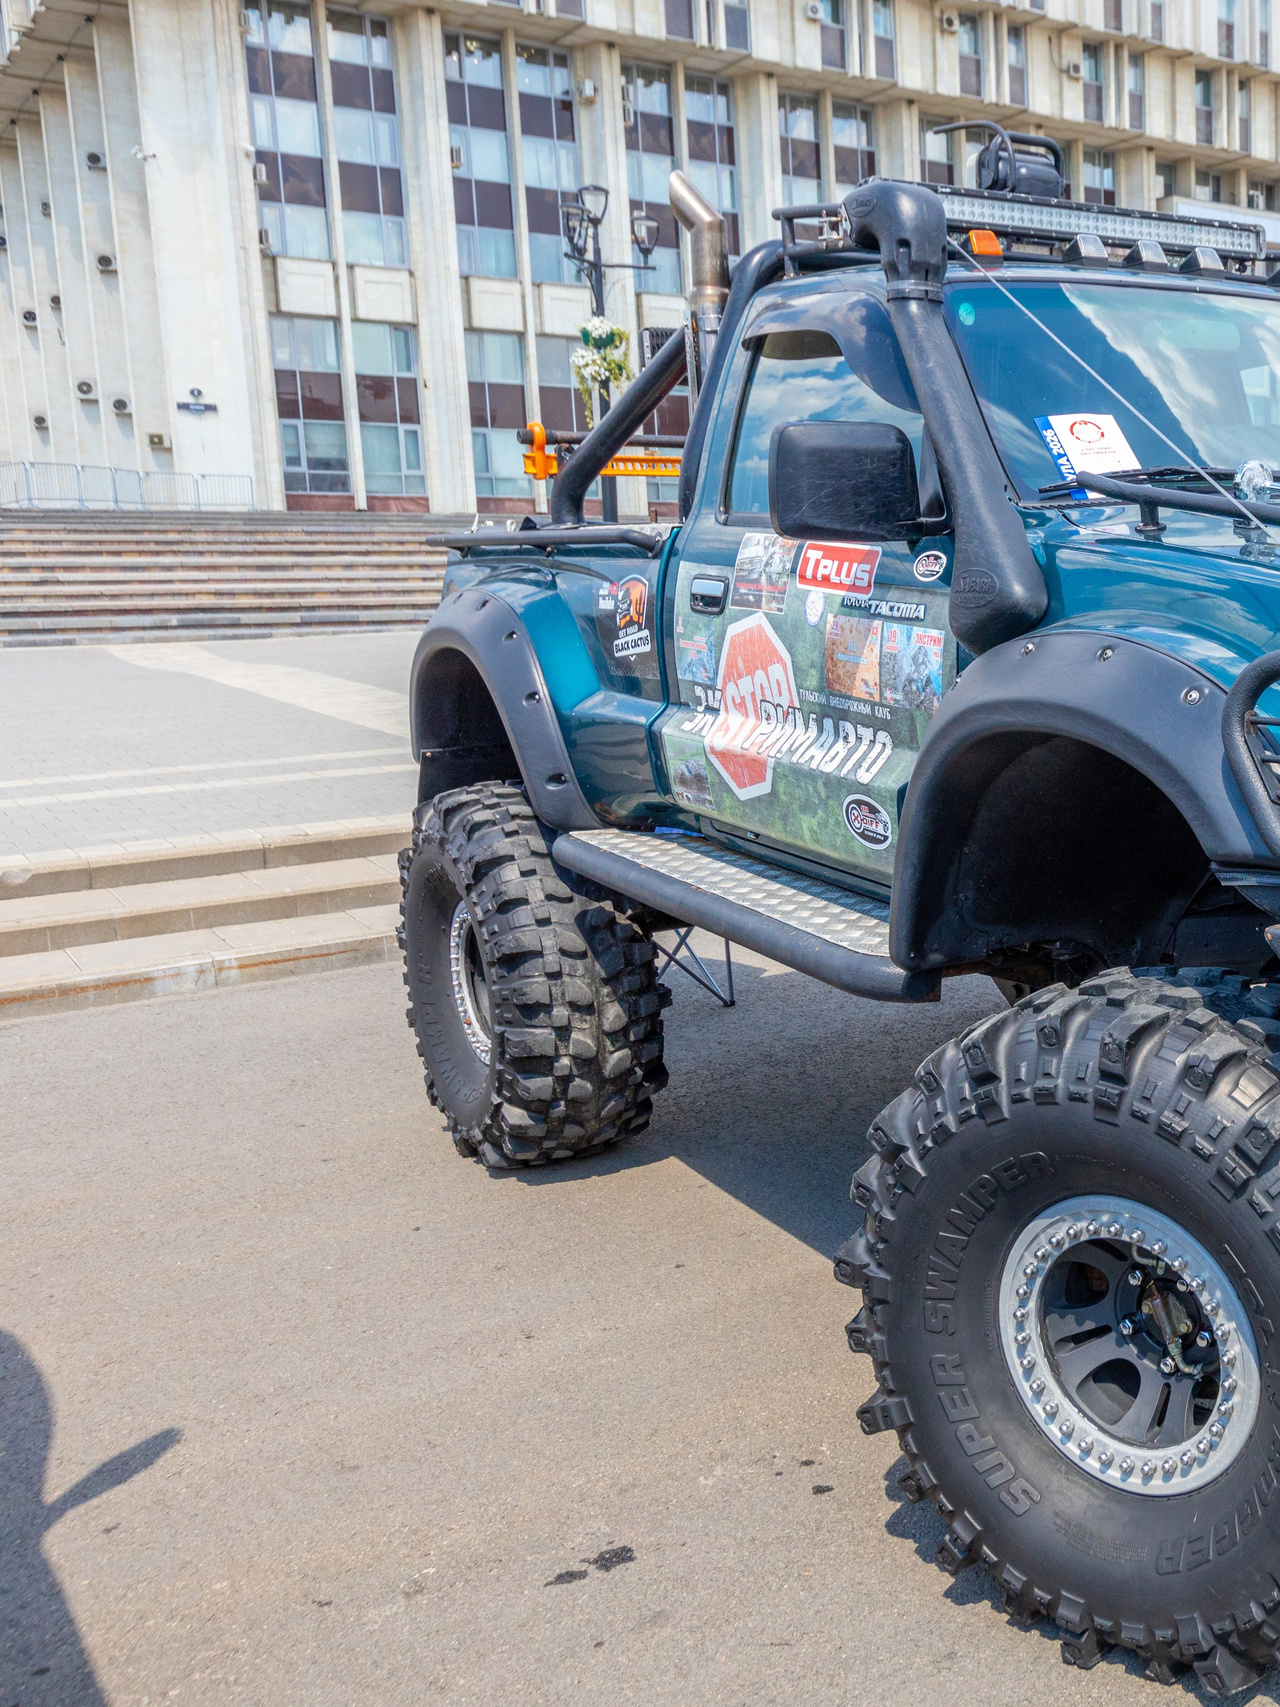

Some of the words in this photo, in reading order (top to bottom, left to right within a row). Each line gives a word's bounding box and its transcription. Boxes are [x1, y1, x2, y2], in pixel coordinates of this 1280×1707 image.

[1042, 428, 1065, 455] 2026
[806, 550, 872, 587] TPLUS
[843, 596, 870, 608] TOYOTA
[869, 600, 926, 619] TACOMA
[614, 640, 630, 654] BLACK
[630, 635, 650, 650] CACTUS
[889, 630, 897, 643] 19
[915, 633, 942, 647] ЭКСТРИМ
[799, 689, 828, 705] ТУЛЬСКИЙ
[874, 706, 891, 720] КЛУБ
[922, 1150, 1057, 1338] SWAMPER
[928, 1353, 1043, 1518] SUPER
